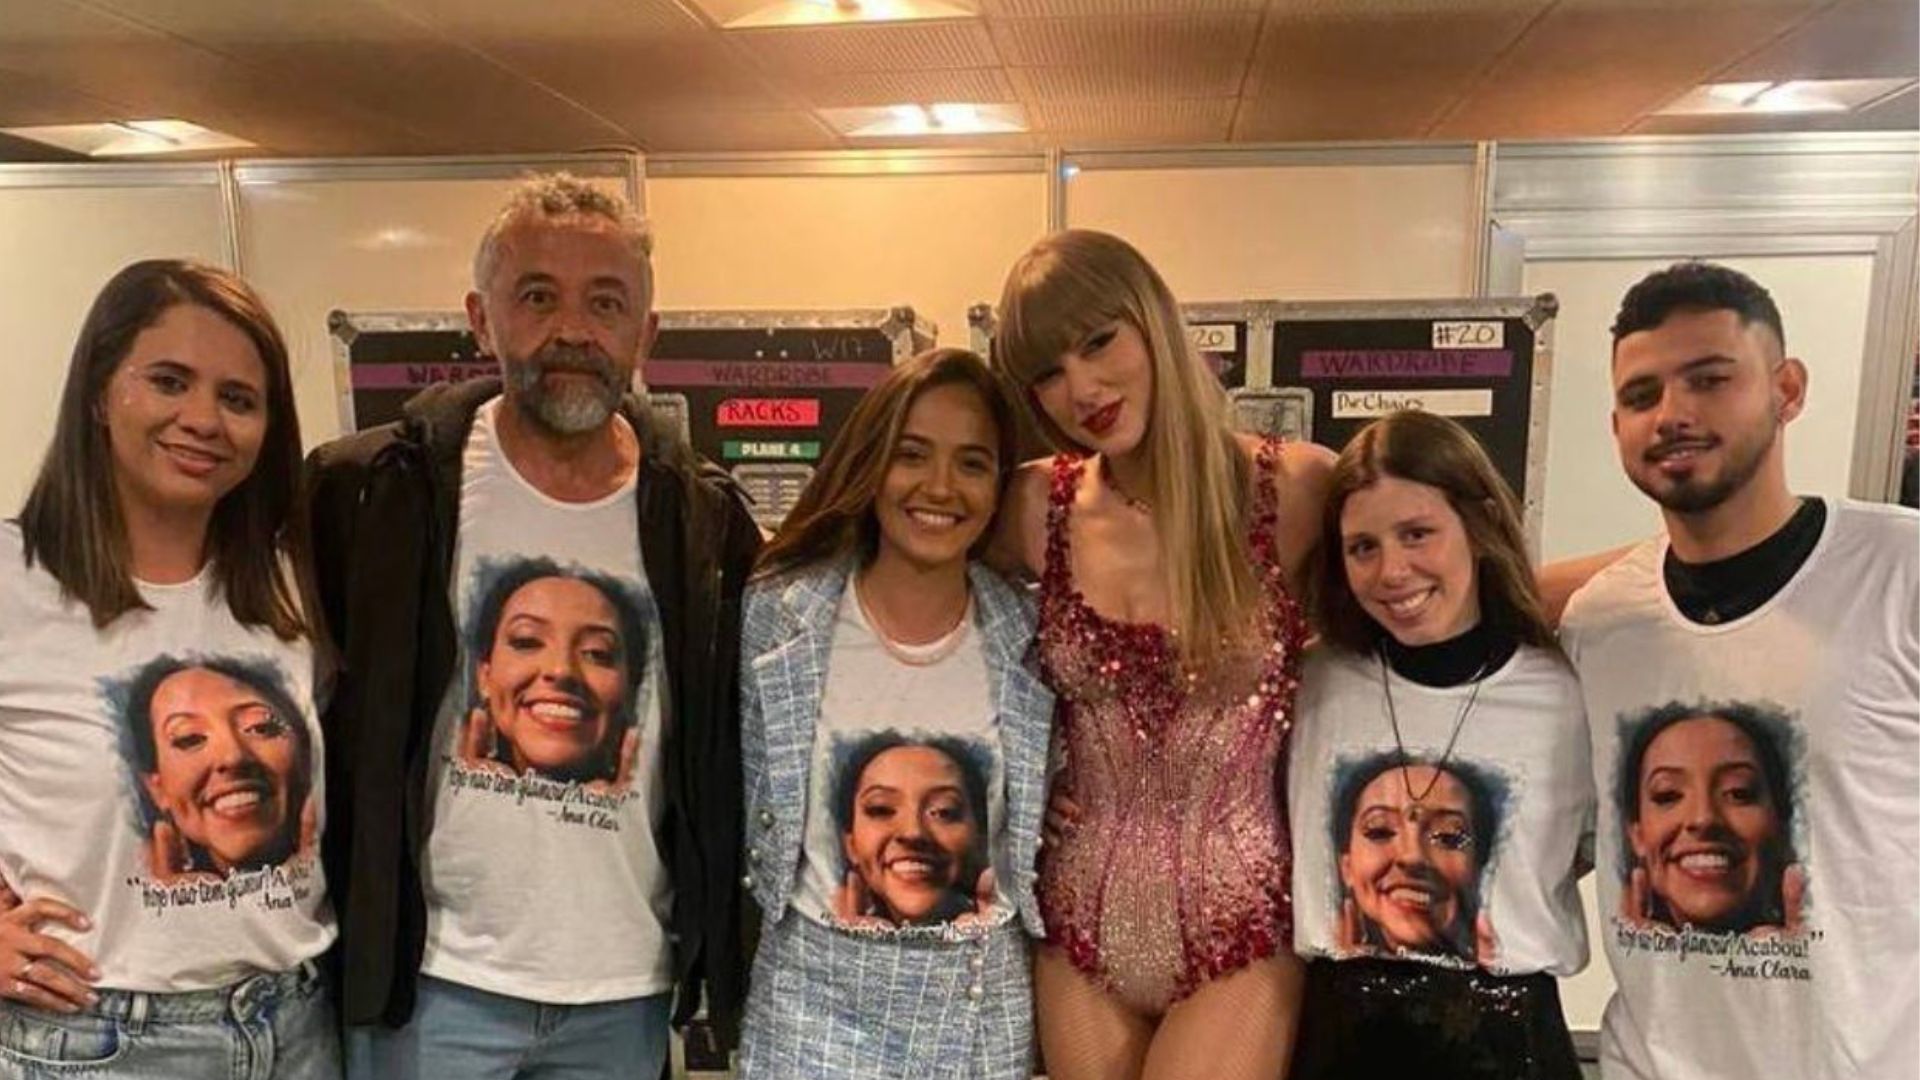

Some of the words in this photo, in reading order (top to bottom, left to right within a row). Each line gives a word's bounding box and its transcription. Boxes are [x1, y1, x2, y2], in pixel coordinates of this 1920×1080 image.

[1436, 325, 1495, 345] #20
[1320, 352, 1479, 374] WARDROBE
[712, 365, 831, 384] WARDROBE
[726, 402, 801, 422] RACKS
[741, 442, 786, 457] PLANE
